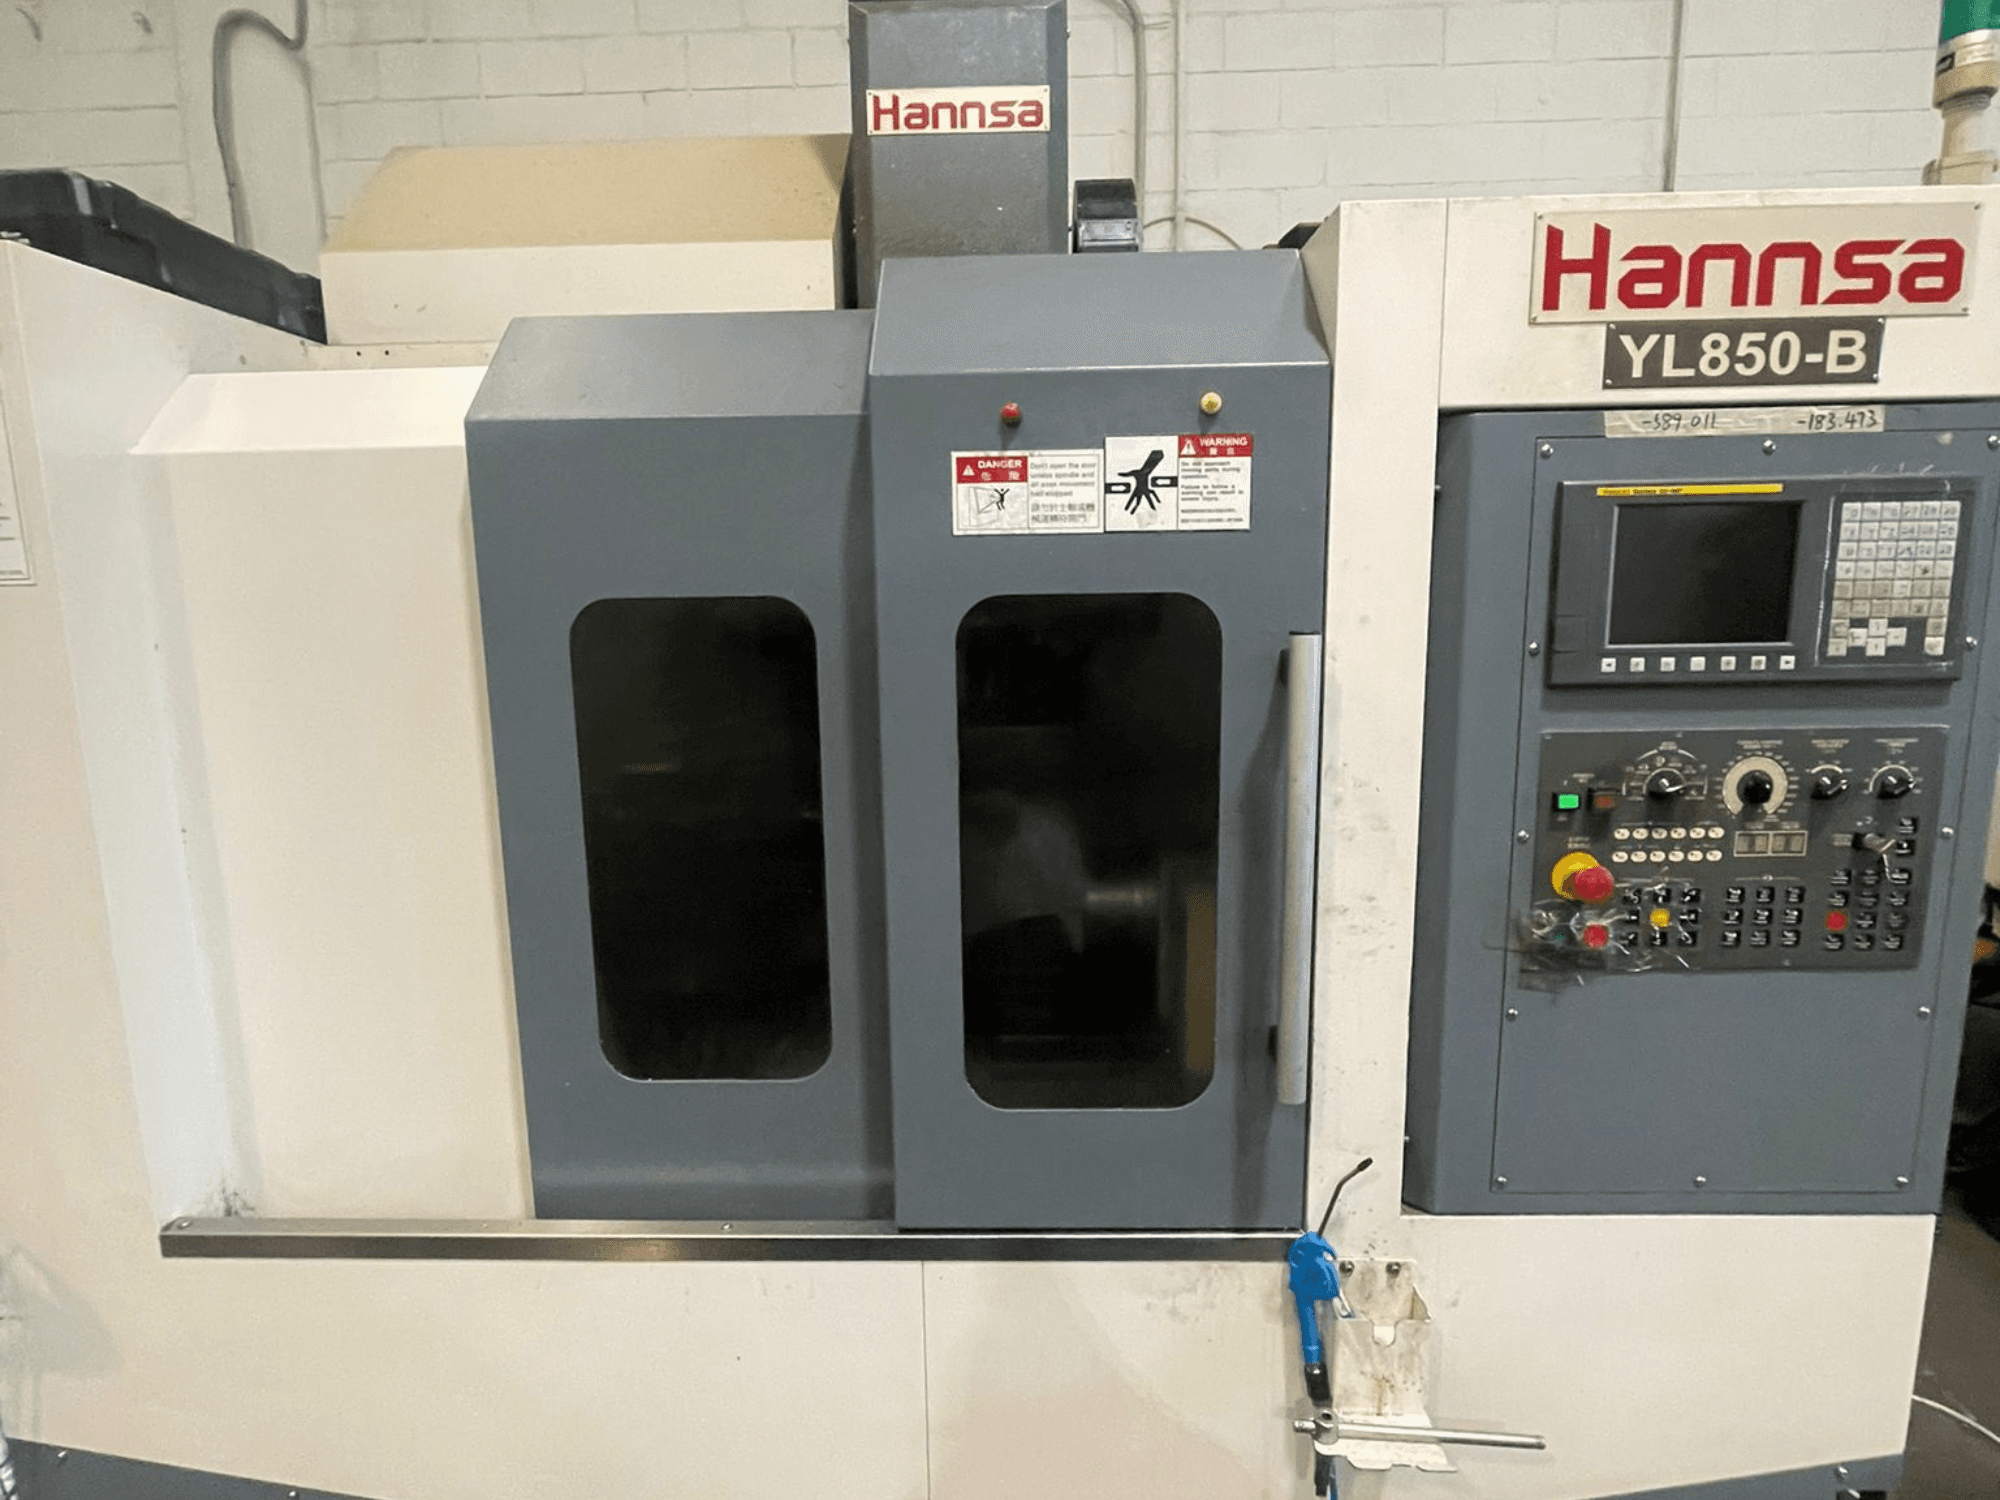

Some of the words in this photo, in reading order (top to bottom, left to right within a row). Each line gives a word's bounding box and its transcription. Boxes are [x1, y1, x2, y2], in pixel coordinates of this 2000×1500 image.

[872, 94, 1044, 131] Hannsa
[1541, 222, 1966, 311] Hannsa
[1618, 329, 1868, 379] YL850-B
[1199, 437, 1248, 446] WARNING
[977, 458, 1023, 469] DANGER
